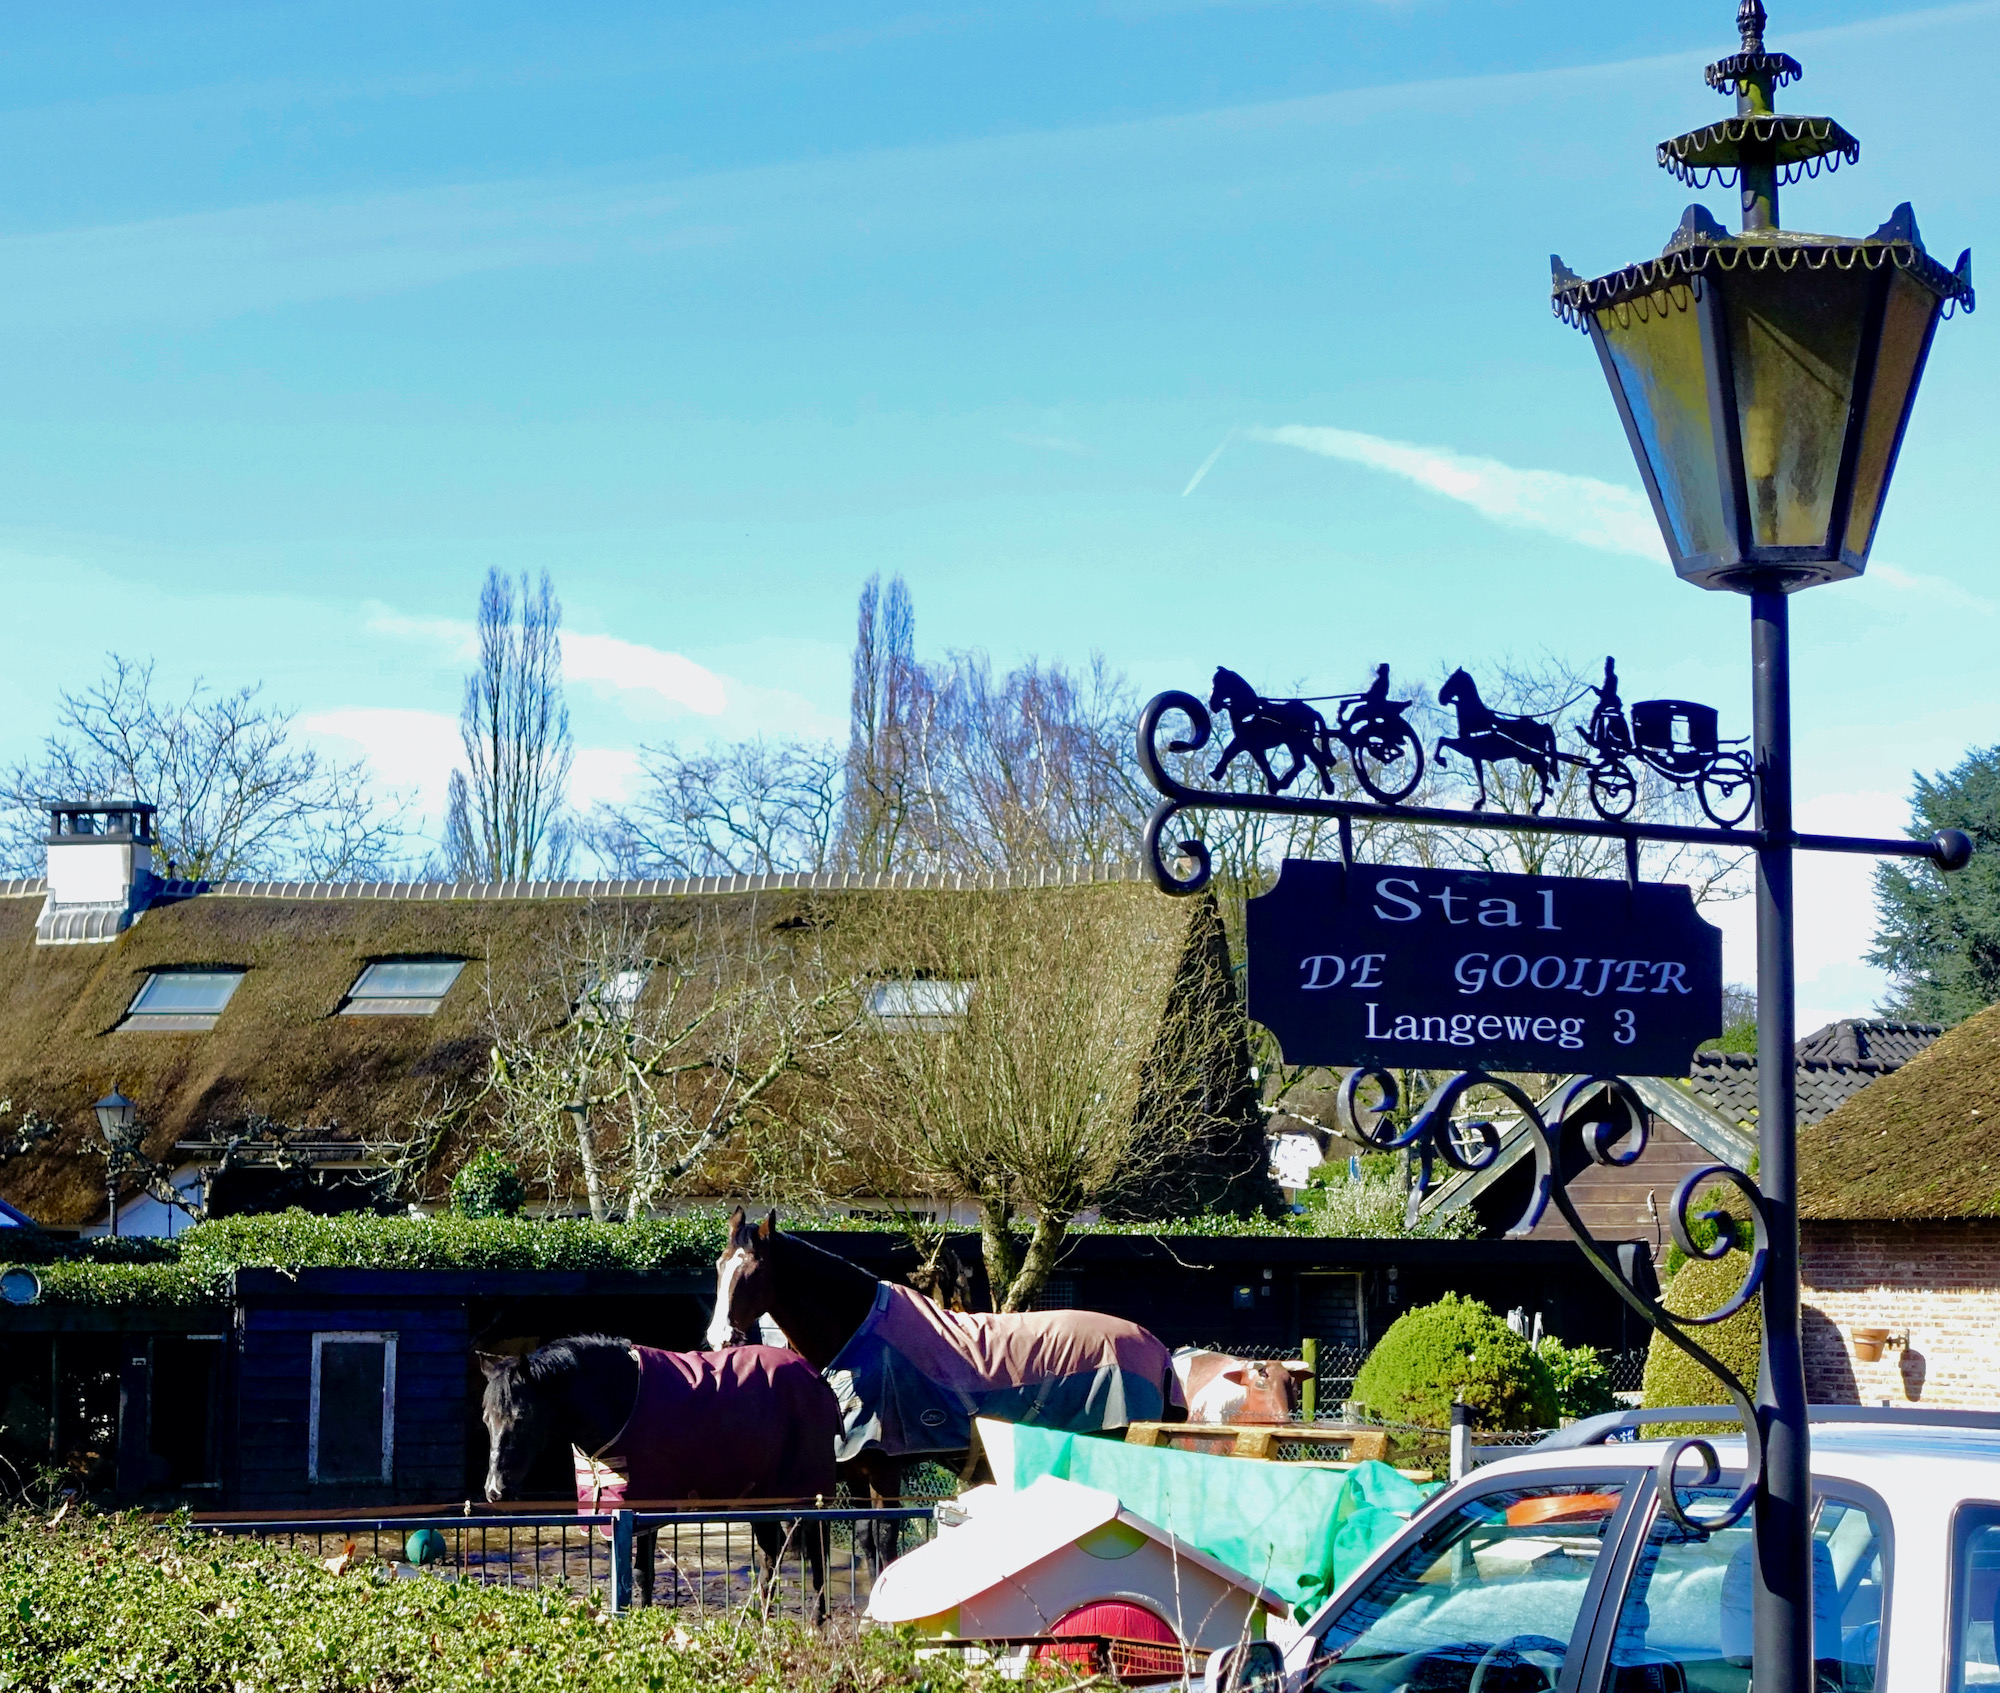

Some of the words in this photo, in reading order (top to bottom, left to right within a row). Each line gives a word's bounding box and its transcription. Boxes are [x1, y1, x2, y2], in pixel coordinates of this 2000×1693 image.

[1373, 878, 1563, 930] Stal
[1299, 953, 1387, 991] DE
[1454, 952, 1693, 997] GOOIJER
[1364, 1002, 1586, 1050] Langeweg
[1613, 1008, 1637, 1044] 3
